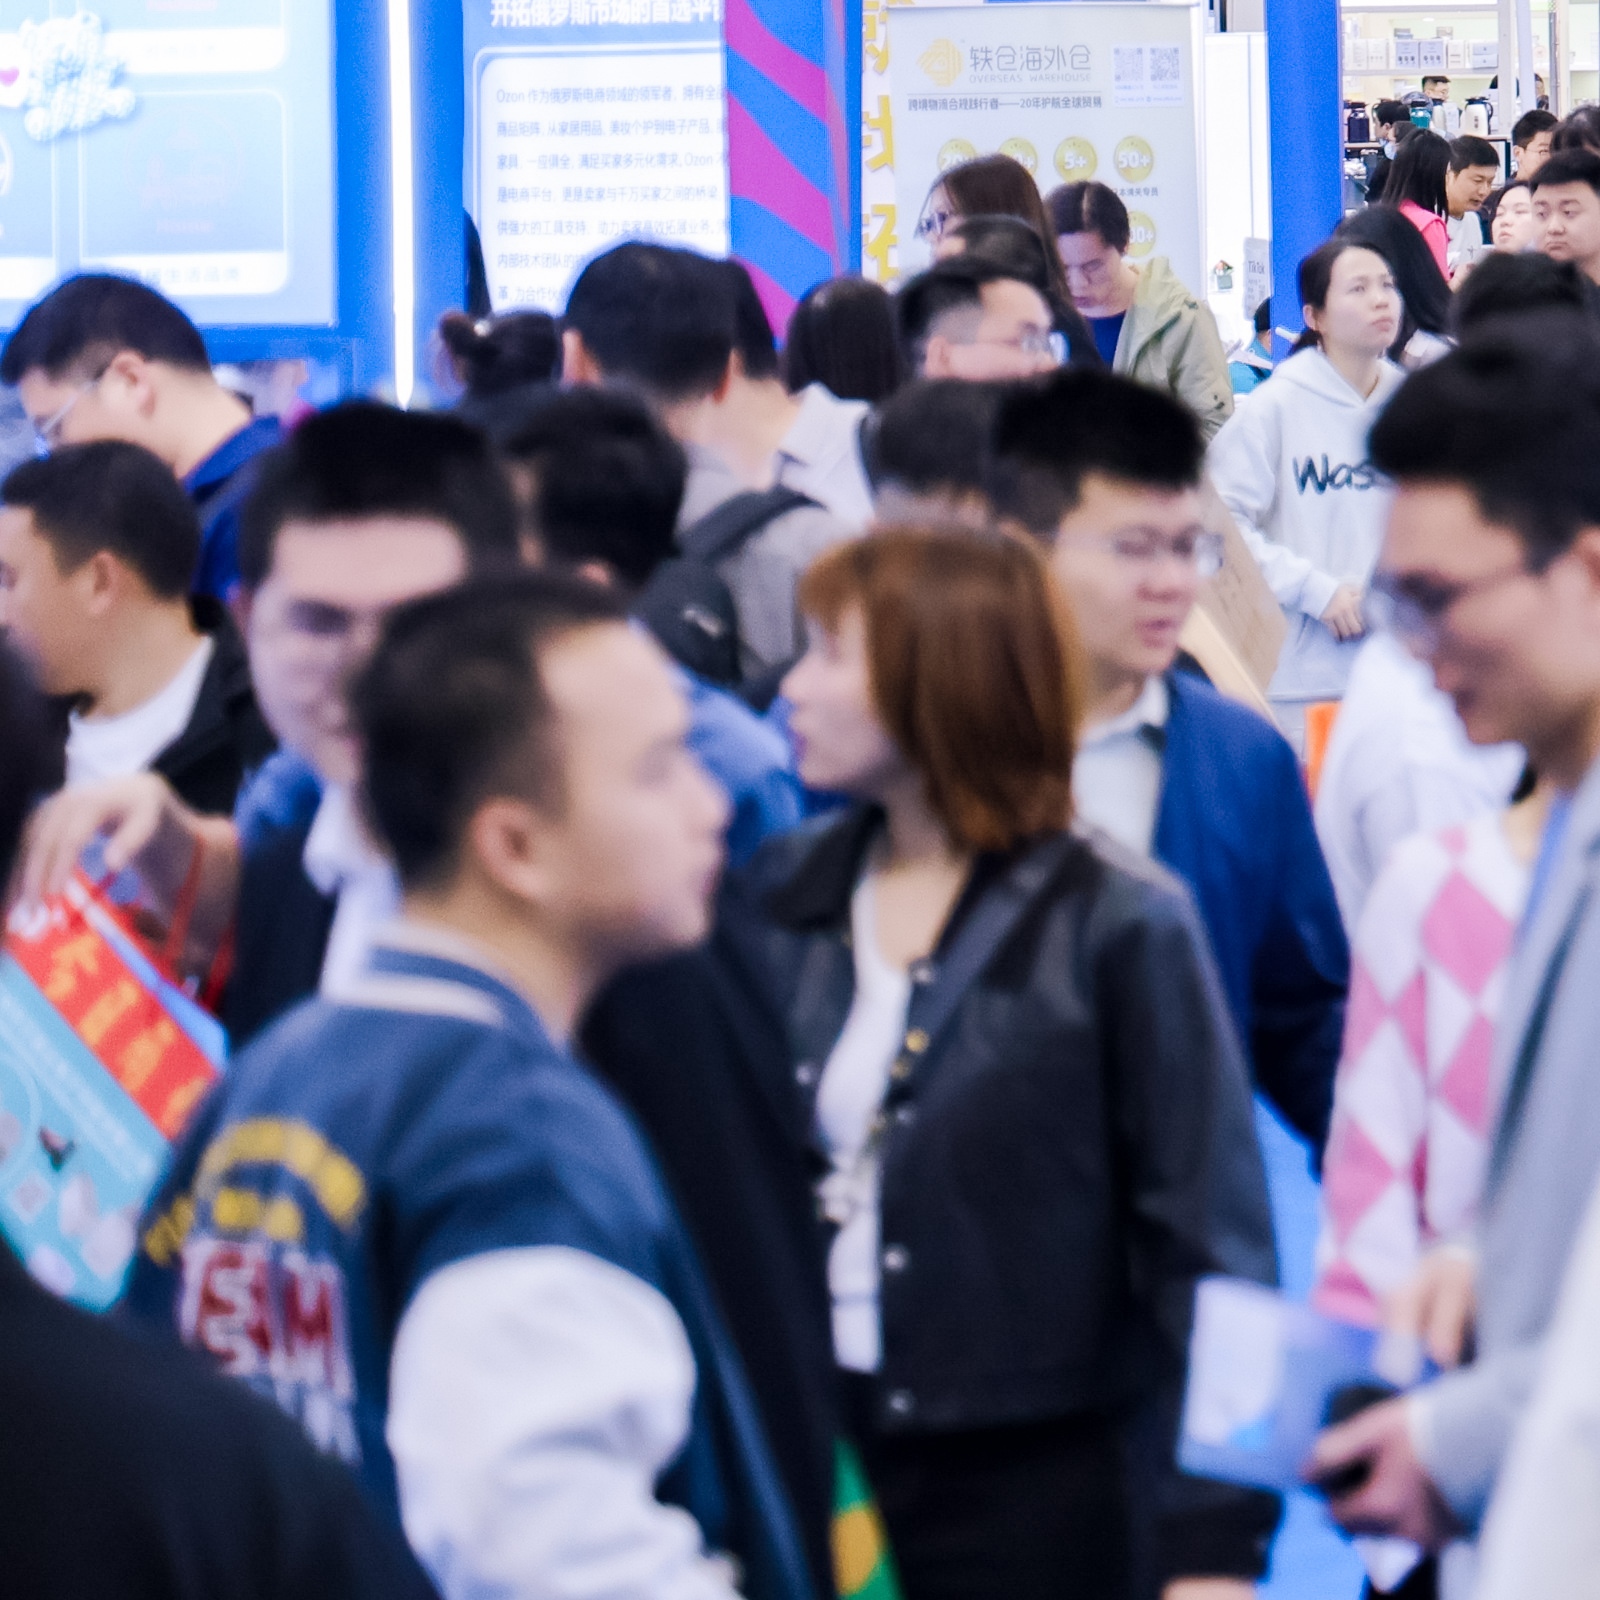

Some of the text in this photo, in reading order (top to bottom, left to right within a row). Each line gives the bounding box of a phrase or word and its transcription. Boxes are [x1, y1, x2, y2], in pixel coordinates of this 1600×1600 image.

[969, 73, 1091, 84] OVERSEAS WAREHOUSE
[1064, 152, 1087, 170] 5+
[1117, 151, 1150, 170] 50+
[1292, 453, 1376, 496] Was
